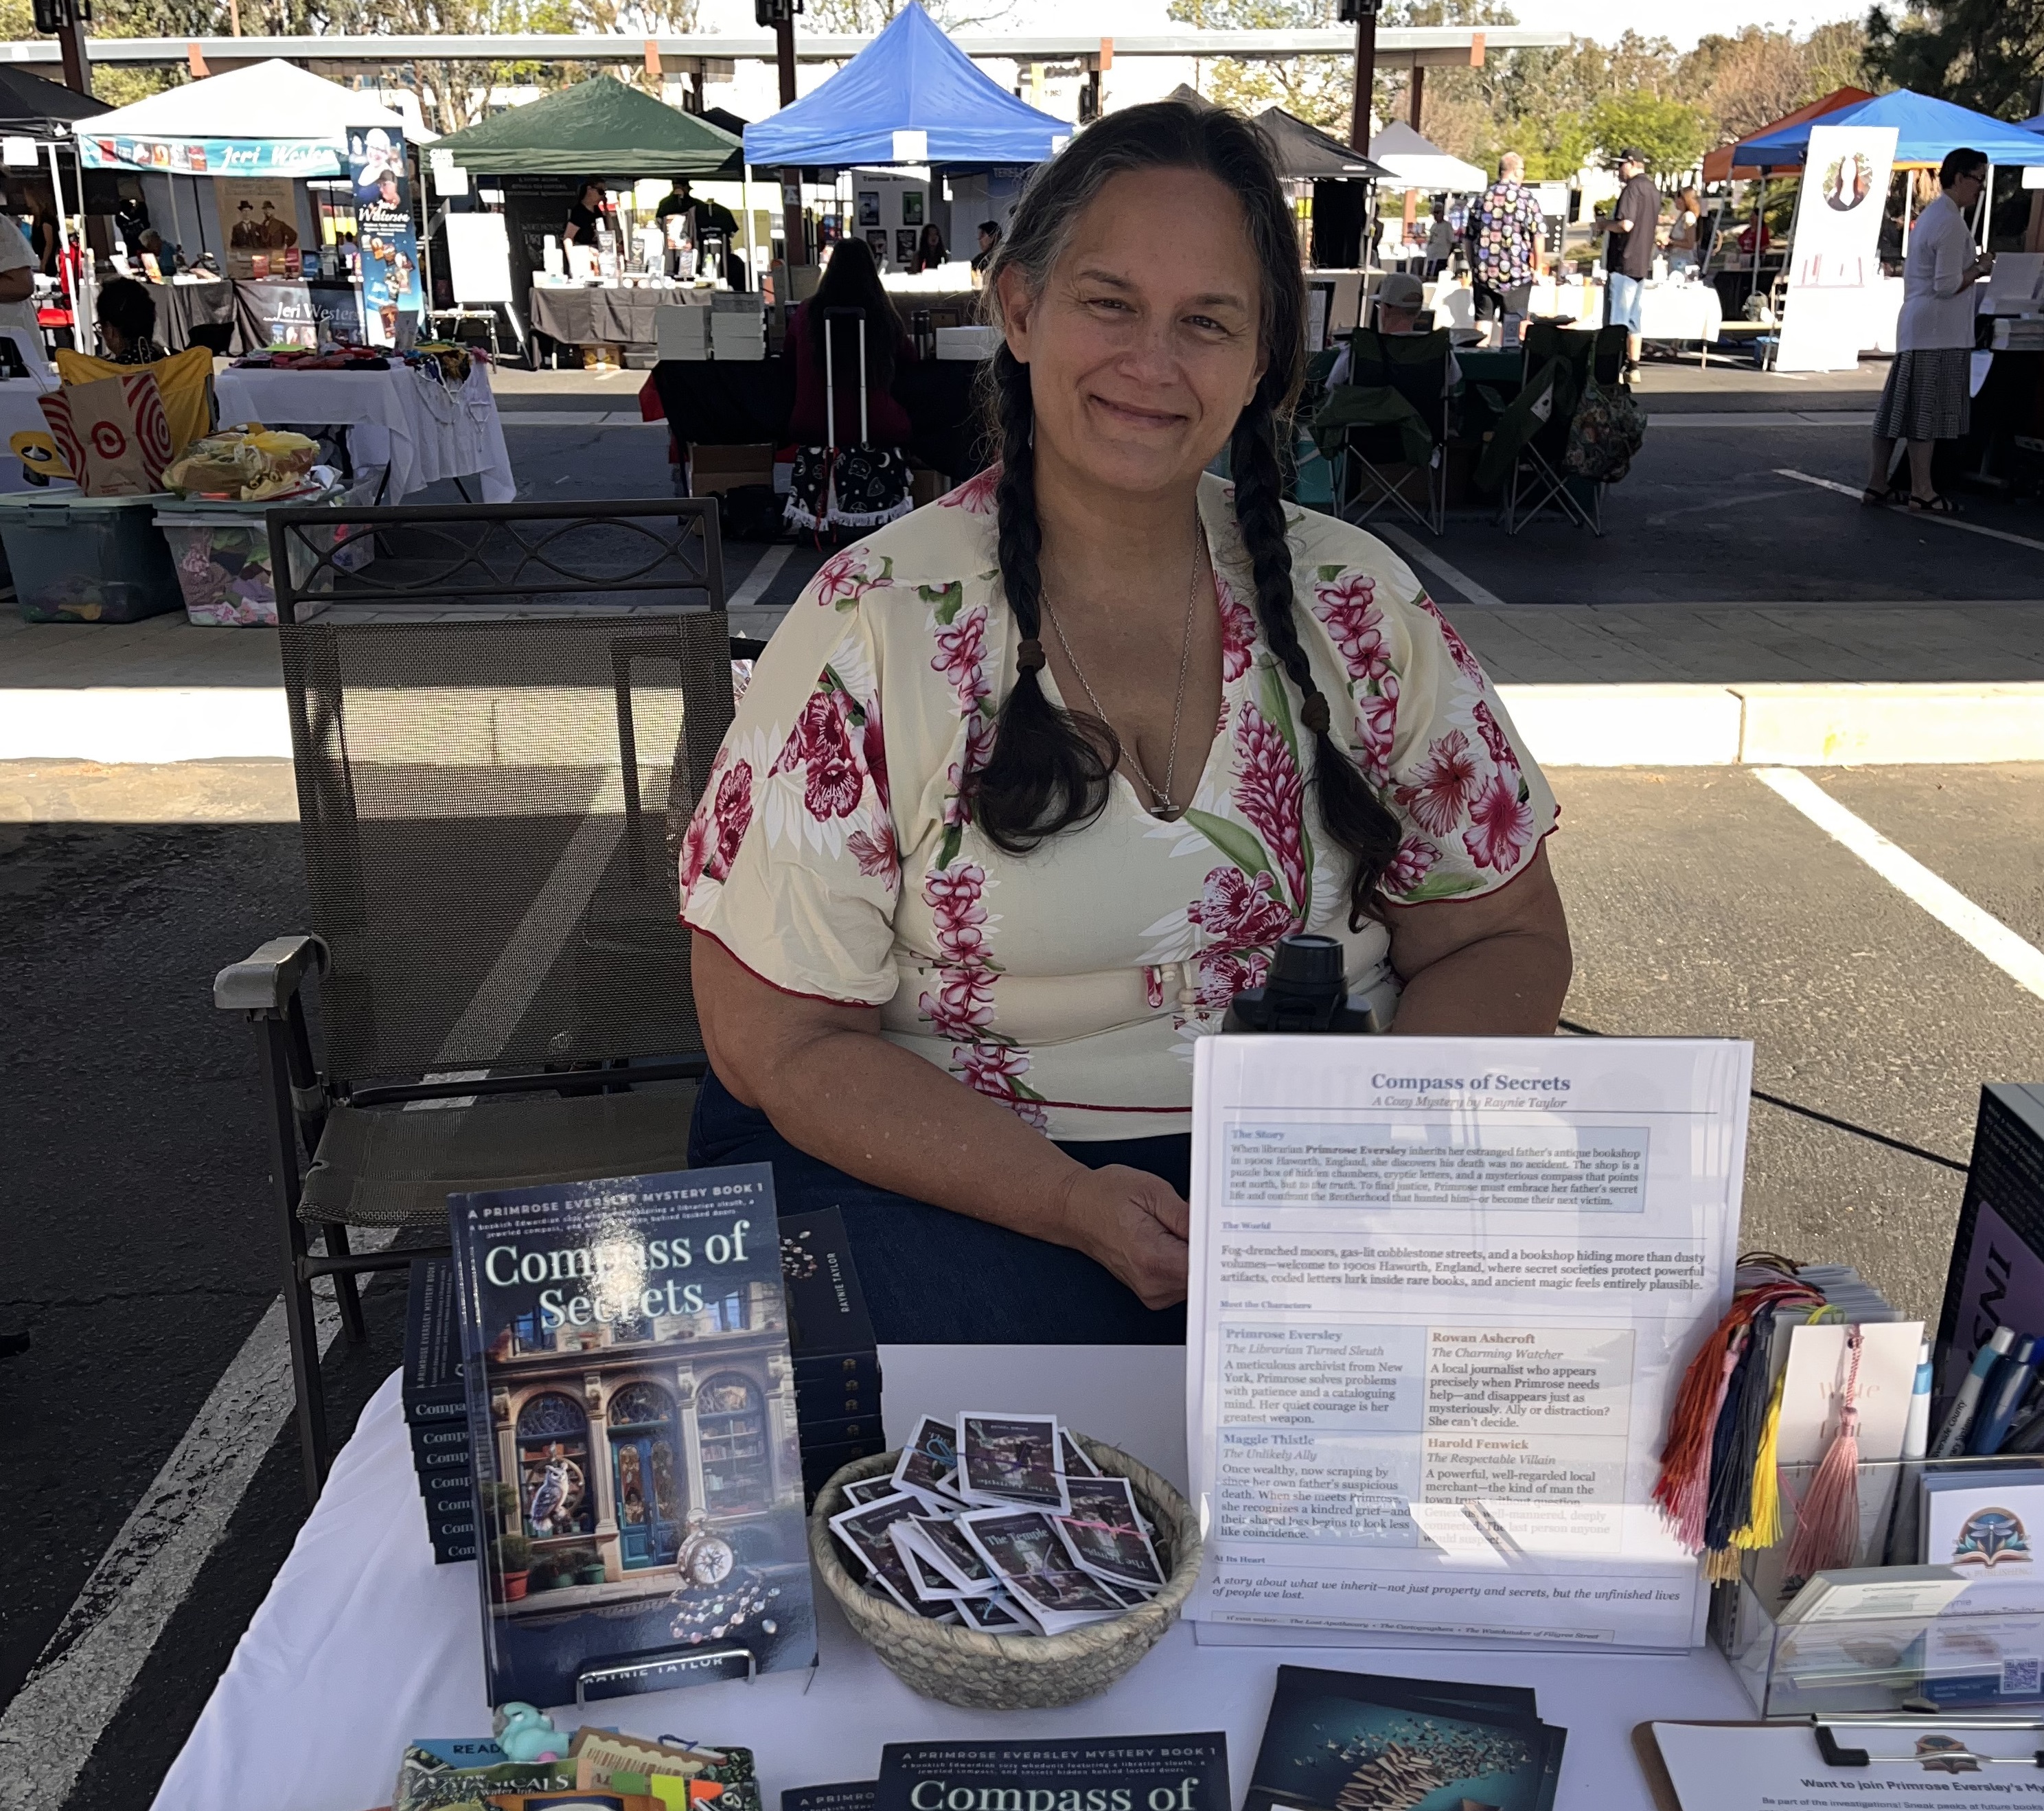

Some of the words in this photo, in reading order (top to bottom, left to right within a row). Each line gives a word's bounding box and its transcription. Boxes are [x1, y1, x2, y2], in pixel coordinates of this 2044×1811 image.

[220, 145, 261, 171] Jeri
[276, 301, 301, 321] Jeri
[1370, 1073, 1465, 1093] Compass
[1469, 1073, 1492, 1090] of
[1495, 1074, 1571, 1091] Secrets
[467, 1209, 479, 1220] A
[483, 1201, 560, 1219] PRIMROSE
[643, 1187, 708, 1203] MYSTERY
[712, 1183, 753, 1197] BOOK
[757, 1182, 764, 1193] 1
[704, 1218, 752, 1265] of
[1221, 1244, 1299, 1260] Fog-drenched
[1340, 1246, 1375, 1261] gas-lit
[1376, 1246, 1444, 1258] cobblestone
[1445, 1247, 1486, 1262] streets,
[1487, 1248, 1510, 1259] and
[1511, 1251, 1518, 1260] a
[1519, 1249, 1575, 1264] bookshop
[1576, 1249, 1613, 1264] hiding
[1614, 1253, 1645, 1261] more
[1646, 1250, 1673, 1262] than
[1673, 1251, 1706, 1265] dusty
[826, 1253, 842, 1282] TAYLOR
[834, 1283, 851, 1312] RAYNIE
[1226, 1328, 1285, 1339] Primrose
[1288, 1329, 1342, 1343] Eversley
[1432, 1332, 1477, 1343] Rowan
[1479, 1333, 1535, 1344] Ashcroft
[1225, 1343, 1246, 1354] The
[1248, 1343, 1303, 1354] Librarian
[1306, 1344, 1347, 1355] Turned
[1348, 1345, 1384, 1356] Sleuth
[1432, 1347, 1453, 1358] The
[1454, 1347, 1513, 1361] Charming
[1515, 1348, 1565, 1360] Watcher
[1429, 1363, 1439, 1374] A
[1442, 1363, 1469, 1374] local
[1470, 1363, 1524, 1377] journalist
[1526, 1365, 1550, 1375] who
[1552, 1367, 1596, 1378] appears
[1429, 1376, 1479, 1390] precisely
[1481, 1377, 1512, 1388] when
[1514, 1378, 1565, 1389] Primrose
[1567, 1378, 1600, 1389] needs
[1485, 1390, 1548, 1404] disappears
[1549, 1391, 1570, 1404] just
[1572, 1394, 1585, 1402] as
[1428, 1402, 1502, 1417] mysteriously.
[1505, 1404, 1527, 1417] Ally
[1543, 1404, 1610, 1416] distraction?
[1948, 1399, 1968, 1428] County
[1427, 1415, 1449, 1426] She
[1450, 1416, 1478, 1426] can't
[1480, 1416, 1519, 1427] decide.
[1427, 1438, 1473, 1449] Harold
[1476, 1439, 1529, 1449] Fenwick
[1427, 1453, 1447, 1463] The
[1450, 1453, 1516, 1467] Respectable
[1519, 1454, 1557, 1465] Villain
[985, 1534, 1009, 1546] The
[1009, 1527, 1050, 1543] Temple
[1212, 1585, 1224, 1595] of
[1225, 1585, 1261, 1601] people
[1263, 1590, 1280, 1598] we
[1281, 1588, 1305, 1599] lost.
[1213, 1574, 1221, 1584] A
[1224, 1574, 1252, 1588] story
[1255, 1575, 1287, 1588] about
[1290, 1576, 1318, 1588] what
[1321, 1580, 1337, 1588] we
[1408, 1580, 1429, 1595] just
[1432, 1582, 1482, 1597] property
[1483, 1583, 1506, 1595] and
[1508, 1584, 1549, 1599] secrets,
[1552, 1586, 1571, 1597] but
[1574, 1586, 1592, 1597] the
[1594, 1587, 1652, 1599] unfinished
[1655, 1589, 1680, 1600] lives
[902, 1751, 912, 1760] A
[918, 1750, 998, 1760] PRIMROSE
[1002, 1750, 1081, 1759] EVERSLEY
[1085, 1748, 1156, 1759] MYSTERY
[1160, 1747, 1206, 1757] BOOK
[1210, 1747, 1217, 1755] 1
[910, 1779, 1134, 1811] Compass
[1147, 1775, 1201, 1811] of
[1800, 1777, 1838, 1790] Want
[1839, 1779, 1855, 1790] to
[1857, 1779, 1885, 1792] join
[1885, 1780, 1951, 1792] Primrose
[1951, 1781, 2024, 1794] Eversley's
[799, 1798, 810, 1807] A
[1777, 1797, 1798, 1807] part
[1799, 1797, 1811, 1806] of
[1811, 1798, 1828, 1806] the
